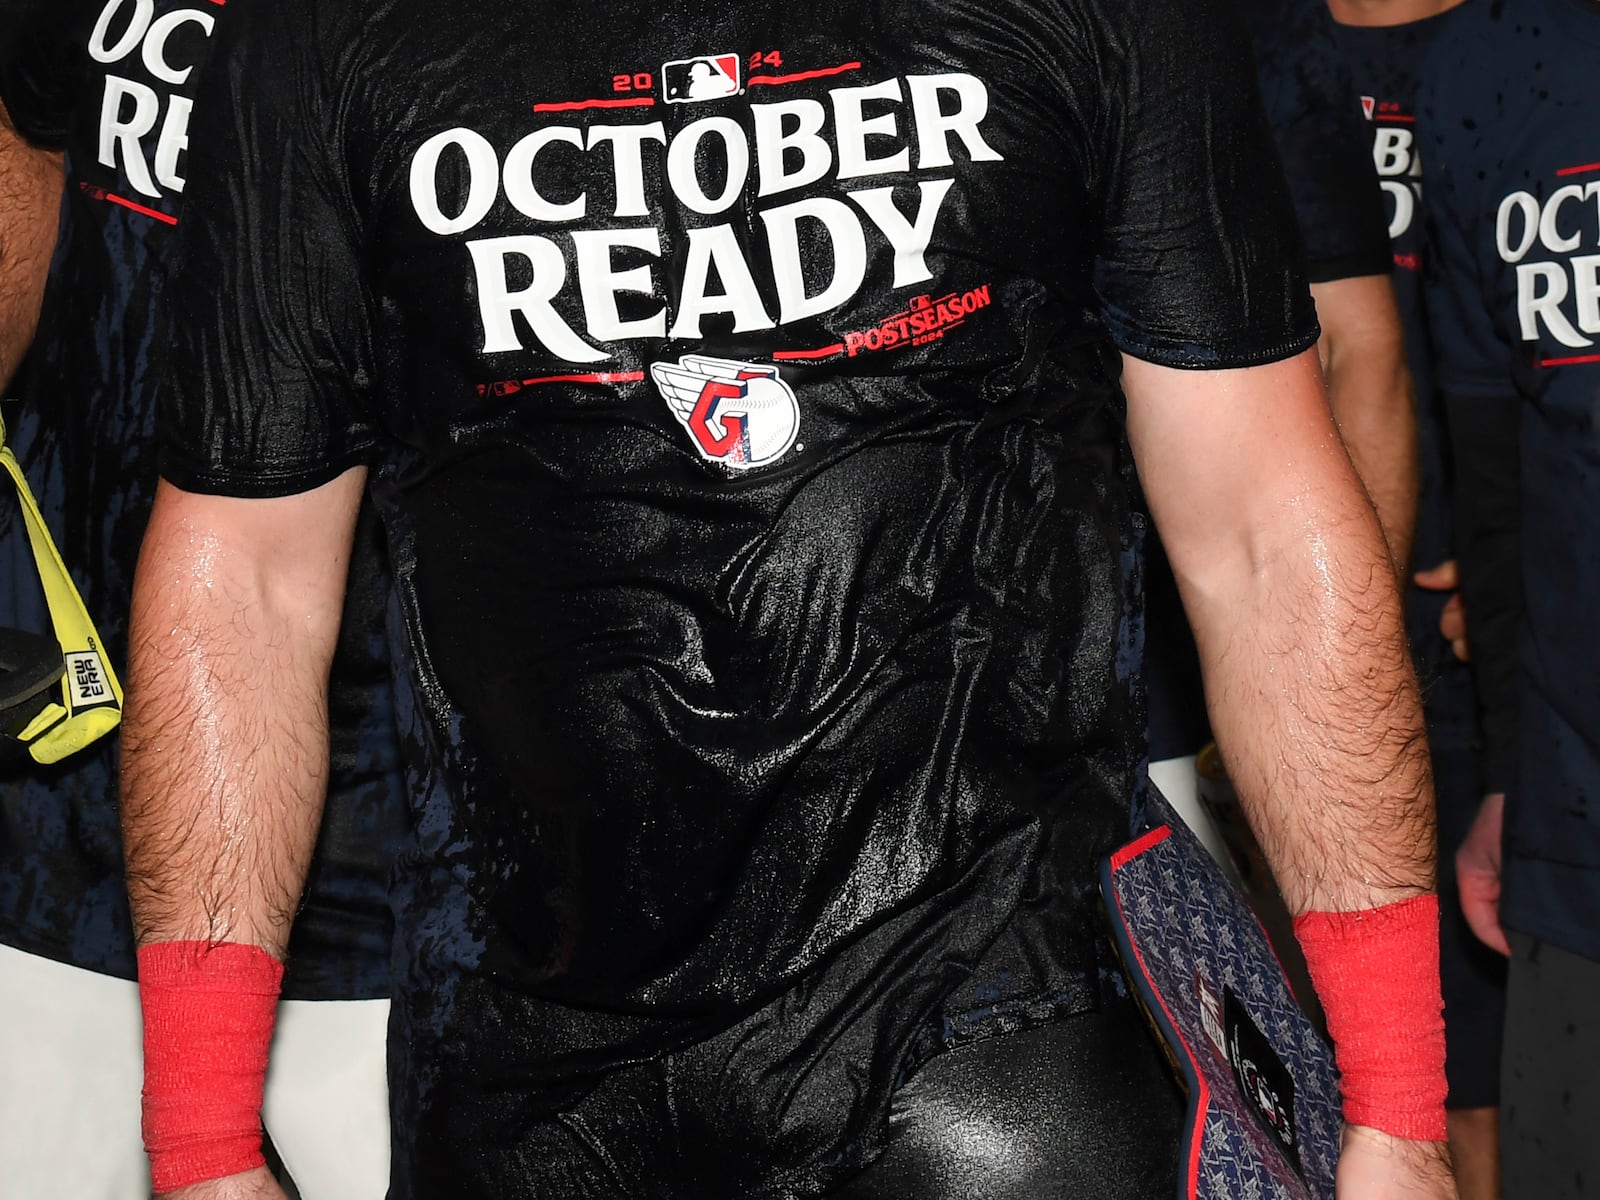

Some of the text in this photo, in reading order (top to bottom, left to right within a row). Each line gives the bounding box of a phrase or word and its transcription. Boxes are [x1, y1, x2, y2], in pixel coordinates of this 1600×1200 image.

[612, 50, 783, 91] 20 24
[409, 73, 1004, 235] OCTOBER
[465, 179, 955, 363] READY
[844, 285, 991, 358] POSTSEASON
[912, 329, 944, 346] 2024
[74, 659, 92, 698] NEW
[85, 658, 104, 696] ERA
